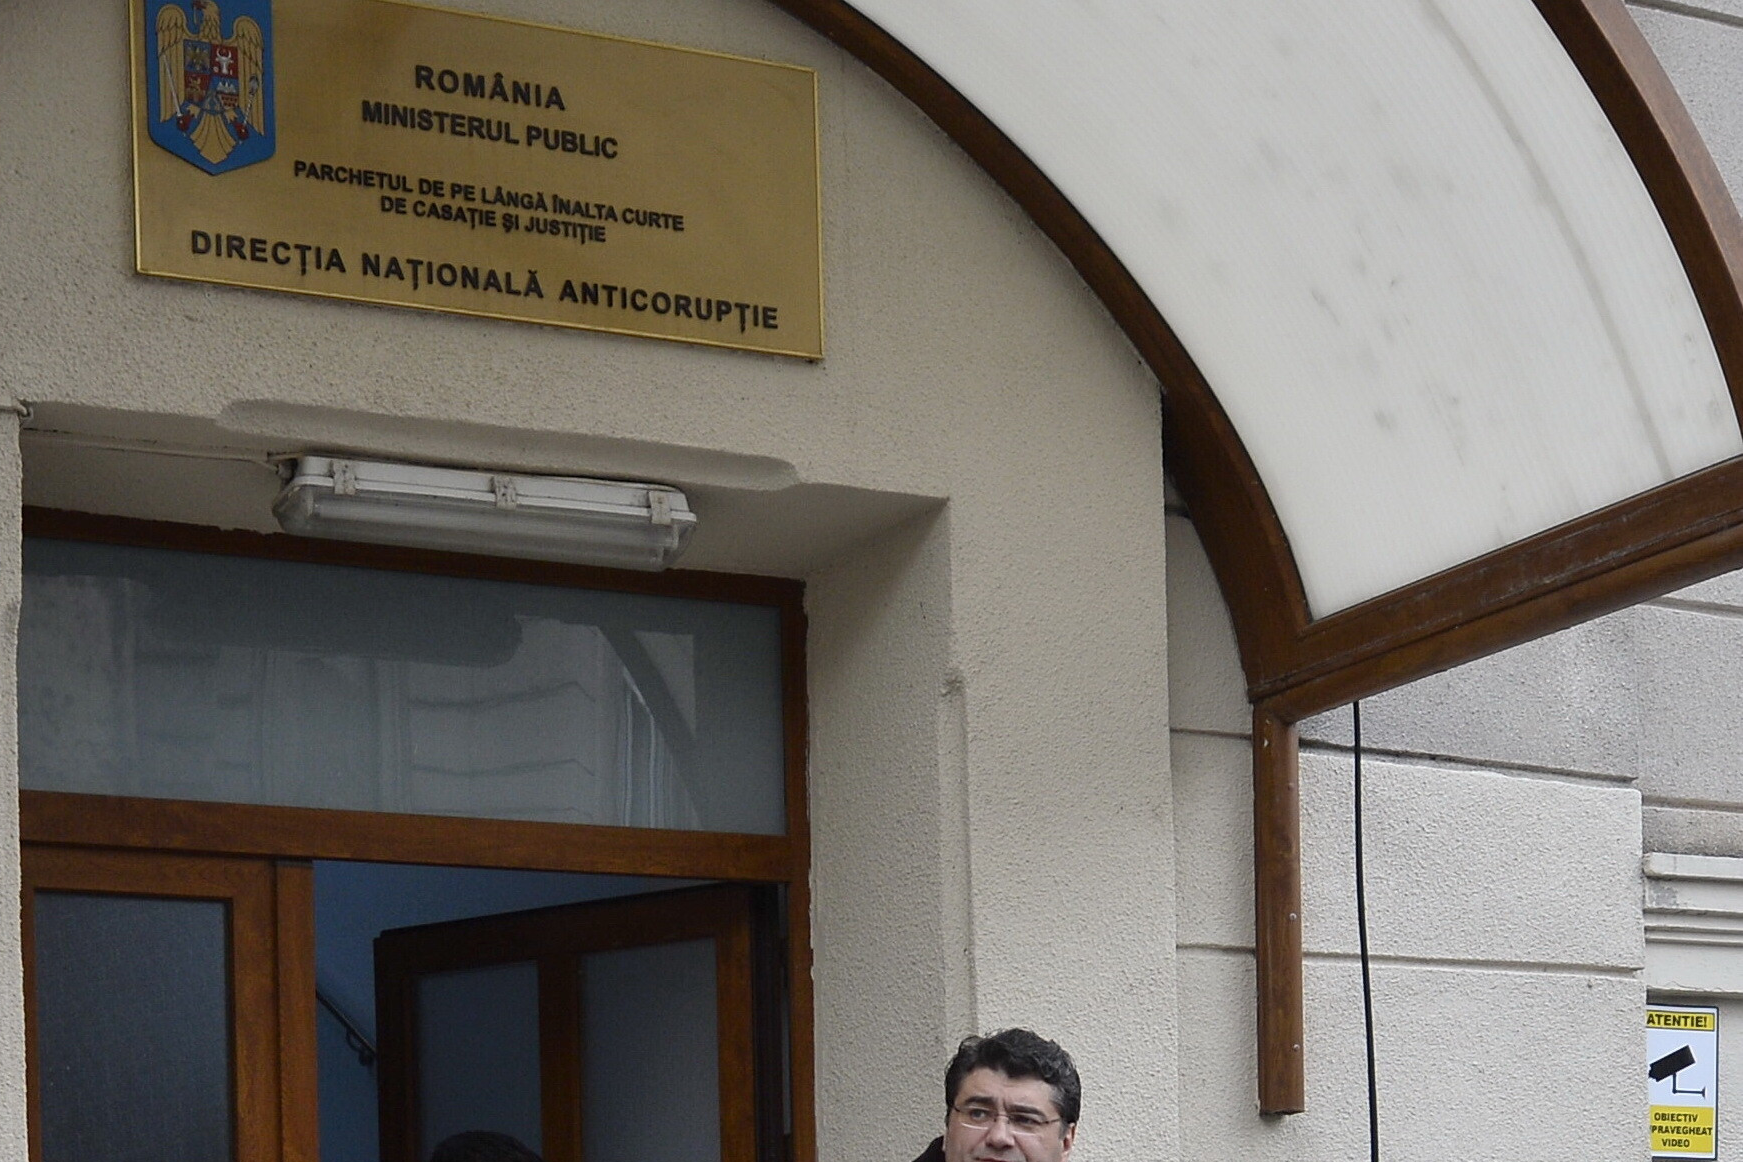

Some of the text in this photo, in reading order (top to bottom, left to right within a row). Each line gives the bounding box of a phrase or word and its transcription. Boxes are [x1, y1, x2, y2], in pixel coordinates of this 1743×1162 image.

[414, 64, 566, 111] ROMÂNIA
[361, 100, 619, 159] MINISTERUL PUBLIC
[293, 160, 685, 232] PARCHETUL DE PE LÂNGĂ ÎNALTA CURTE
[380, 195, 407, 215] DE
[1646, 1013, 1708, 1028] ATENTIE!
[1654, 1112, 1699, 1122] OBIECTIV
[1650, 1124, 1713, 1136] PRAVEGHEAT
[1661, 1138, 1690, 1148] VIDEO
